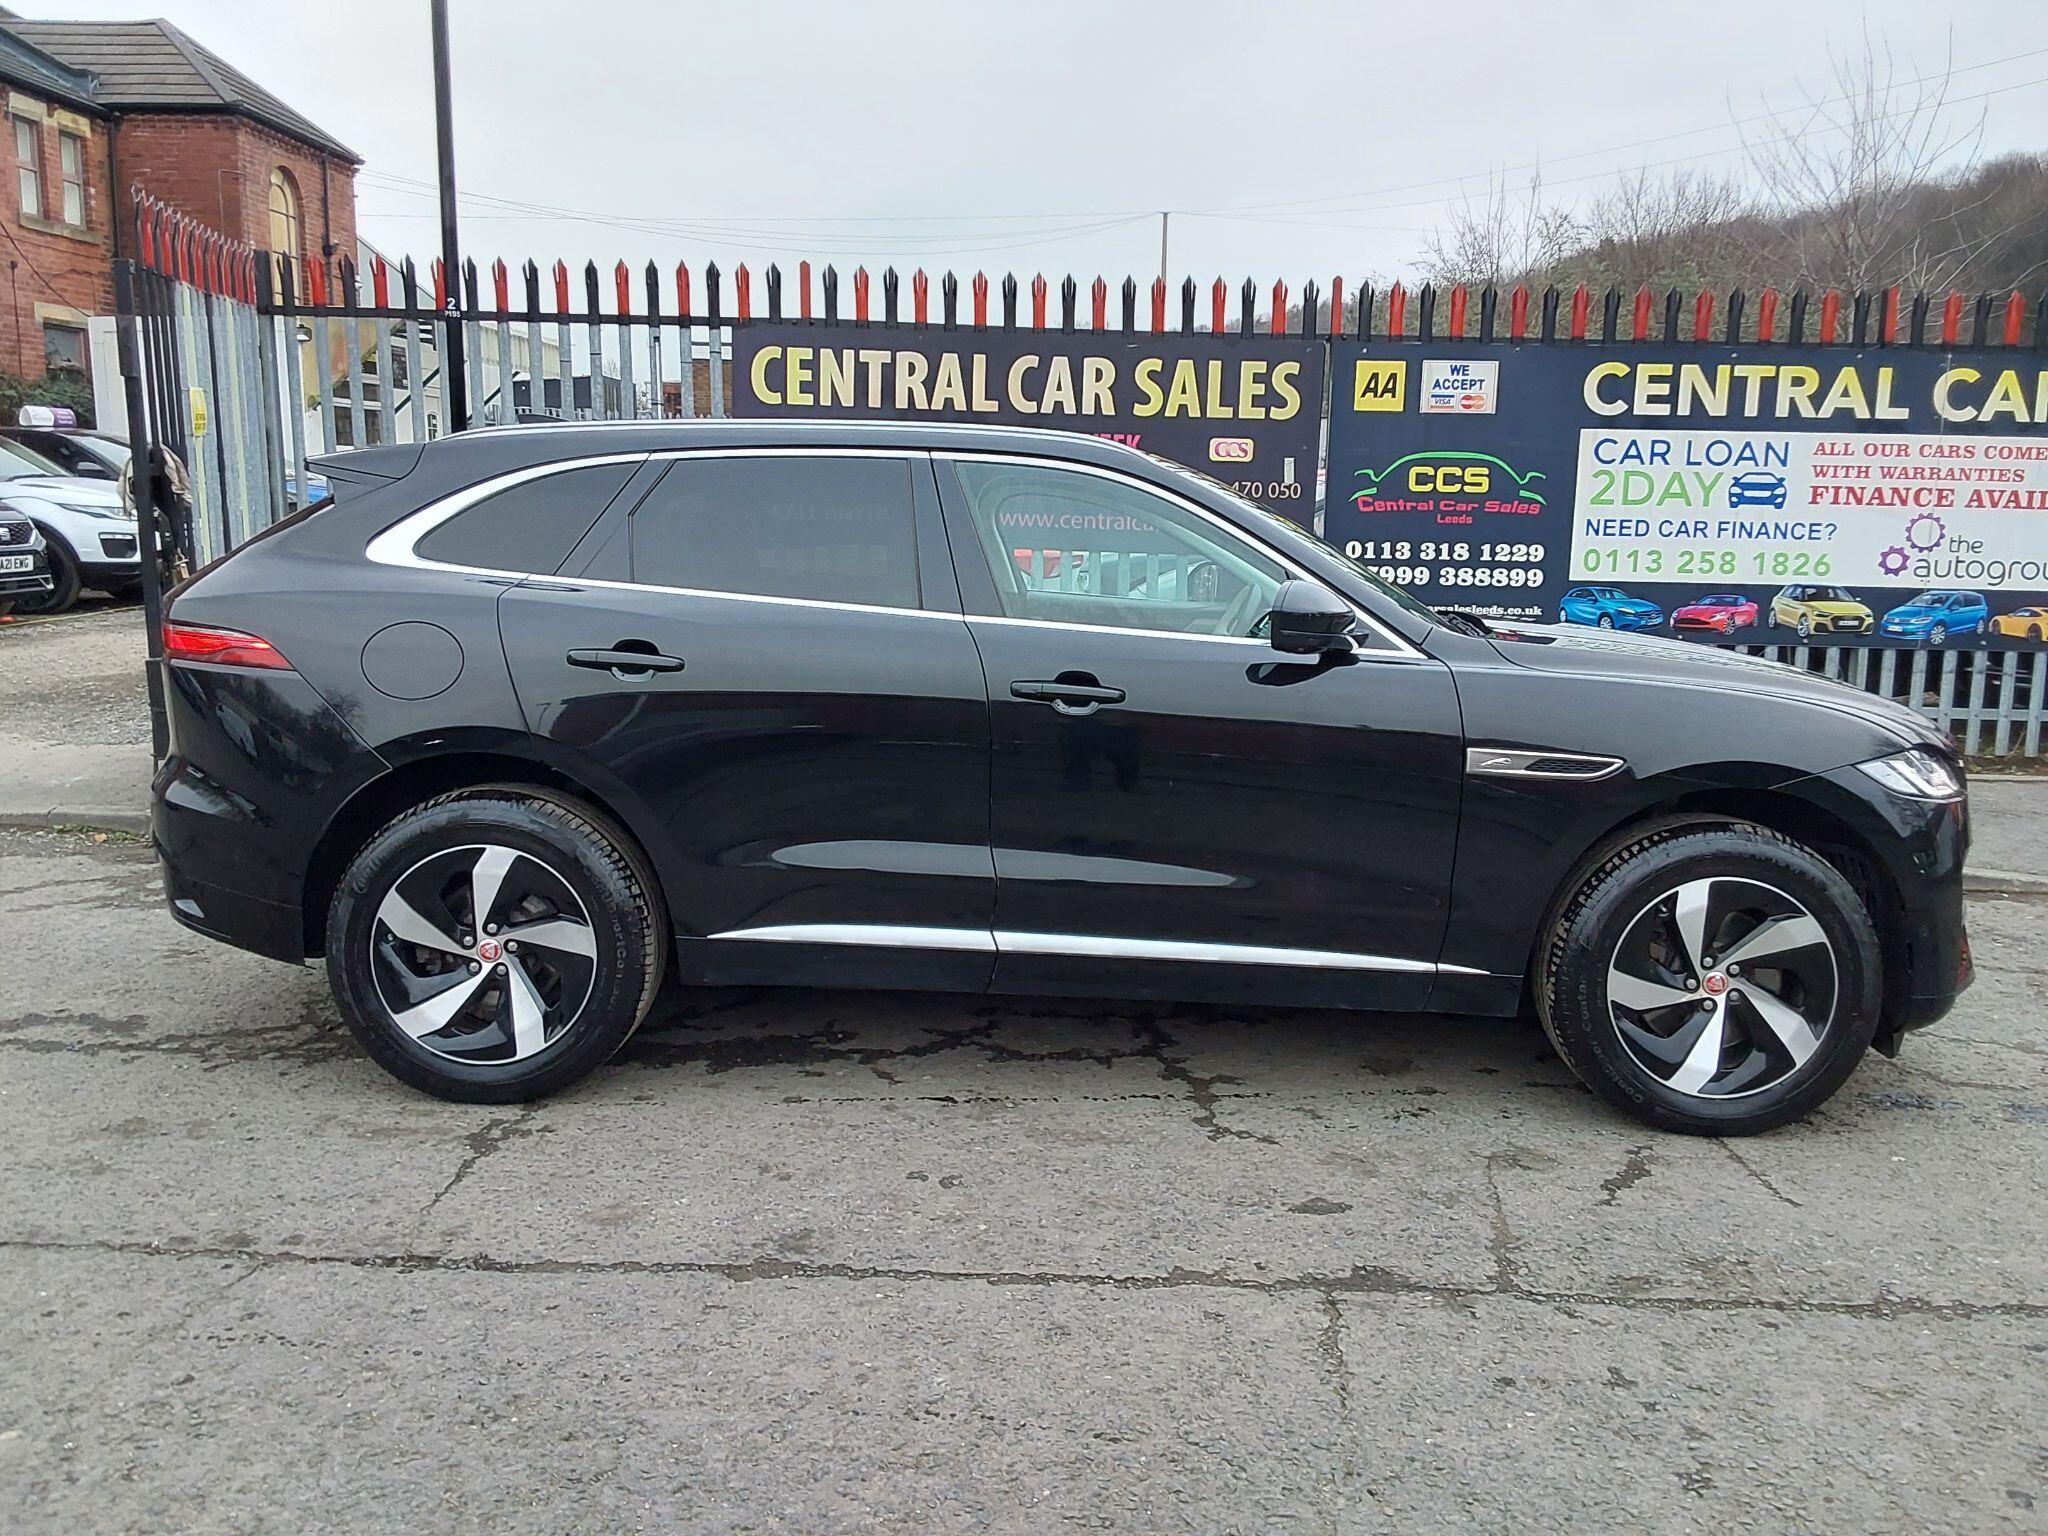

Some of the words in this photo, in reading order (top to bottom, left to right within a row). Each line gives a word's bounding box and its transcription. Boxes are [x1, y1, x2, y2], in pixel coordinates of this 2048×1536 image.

[446, 297, 456, 310] 2
[1450, 364, 1470, 376] WE
[750, 345, 999, 412] CENTRAL
[1007, 355, 1116, 415] CAR
[1133, 357, 1301, 421] SALES
[1360, 372, 1398, 398] AA
[1432, 378, 1485, 391] ACCEPT
[1583, 361, 1910, 419] CENTRAL
[1215, 442, 1248, 458] CCS
[1593, 438, 1671, 466] CAR
[1685, 440, 1789, 467] LOAN
[1813, 442, 1855, 456] ALL
[1863, 443, 1911, 457] OUR
[1919, 445, 1976, 459] CARS
[1984, 445, 2048, 460] COME
[1408, 466, 1490, 493] CCS
[1811, 465, 1871, 479] WITH
[1879, 466, 2026, 482] WARRANTIES
[1268, 482, 1302, 499] 050
[1590, 469, 1724, 507] 2DAY
[1808, 485, 1956, 508] FINANCE
[1357, 496, 1434, 512] Central
[1439, 501, 1479, 511] Car
[1484, 500, 1541, 515] Sales
[1436, 513, 1473, 524] Leeds
[1585, 519, 1650, 537] NEED
[1658, 520, 1708, 538] CAR
[1717, 520, 1838, 541] FINANCE?
[1345, 541, 1411, 560] 0113
[1420, 542, 1470, 561] 318
[1479, 544, 1545, 563] 1229
[1949, 535, 1984, 554] the
[1583, 548, 1662, 573] 0113
[1677, 550, 1736, 574] 258
[1752, 552, 1832, 577] 1826
[1439, 567, 1544, 587] 388899
